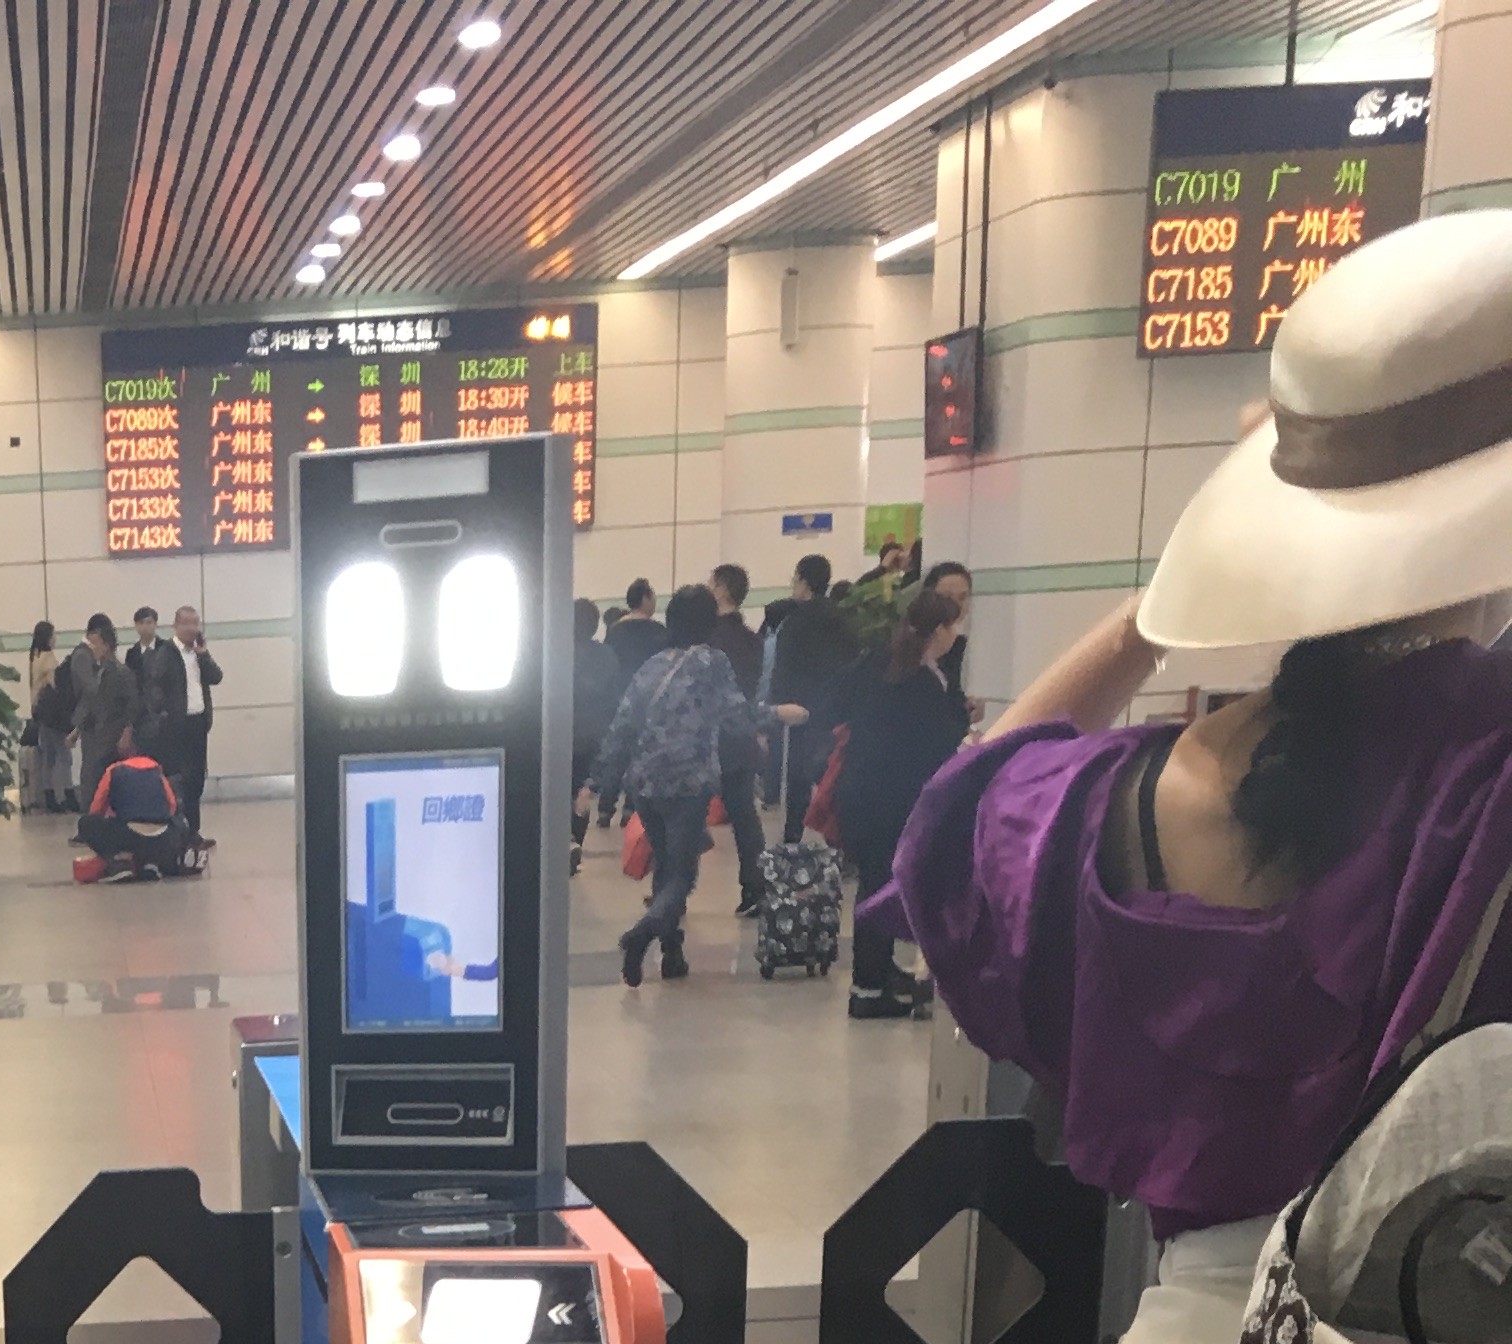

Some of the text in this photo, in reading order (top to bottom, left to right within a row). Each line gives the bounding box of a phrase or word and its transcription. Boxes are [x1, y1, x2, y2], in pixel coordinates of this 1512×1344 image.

[1155, 158, 1368, 206] C7019 广州
[1150, 206, 1365, 257] C7089 广州东
[1148, 258, 1330, 304] C7185 广州
[350, 339, 441, 355] Train Information
[1144, 311, 1231, 350] C7153
[105, 375, 178, 402] C7019次
[210, 369, 271, 397] 广州
[359, 361, 421, 387] 深圳
[458, 357, 529, 382] 18:28开
[105, 404, 179, 433] C7089次
[210, 399, 273, 427] 广州东
[358, 390, 422, 418] 深圳
[105, 433, 179, 462] C7185次
[211, 429, 273, 456] 广州东
[107, 440, 593, 493] C7153次 广州东 车
[108, 470, 592, 522] C7133次 广州东 车
[108, 499, 591, 551] C7143次 广州东 车
